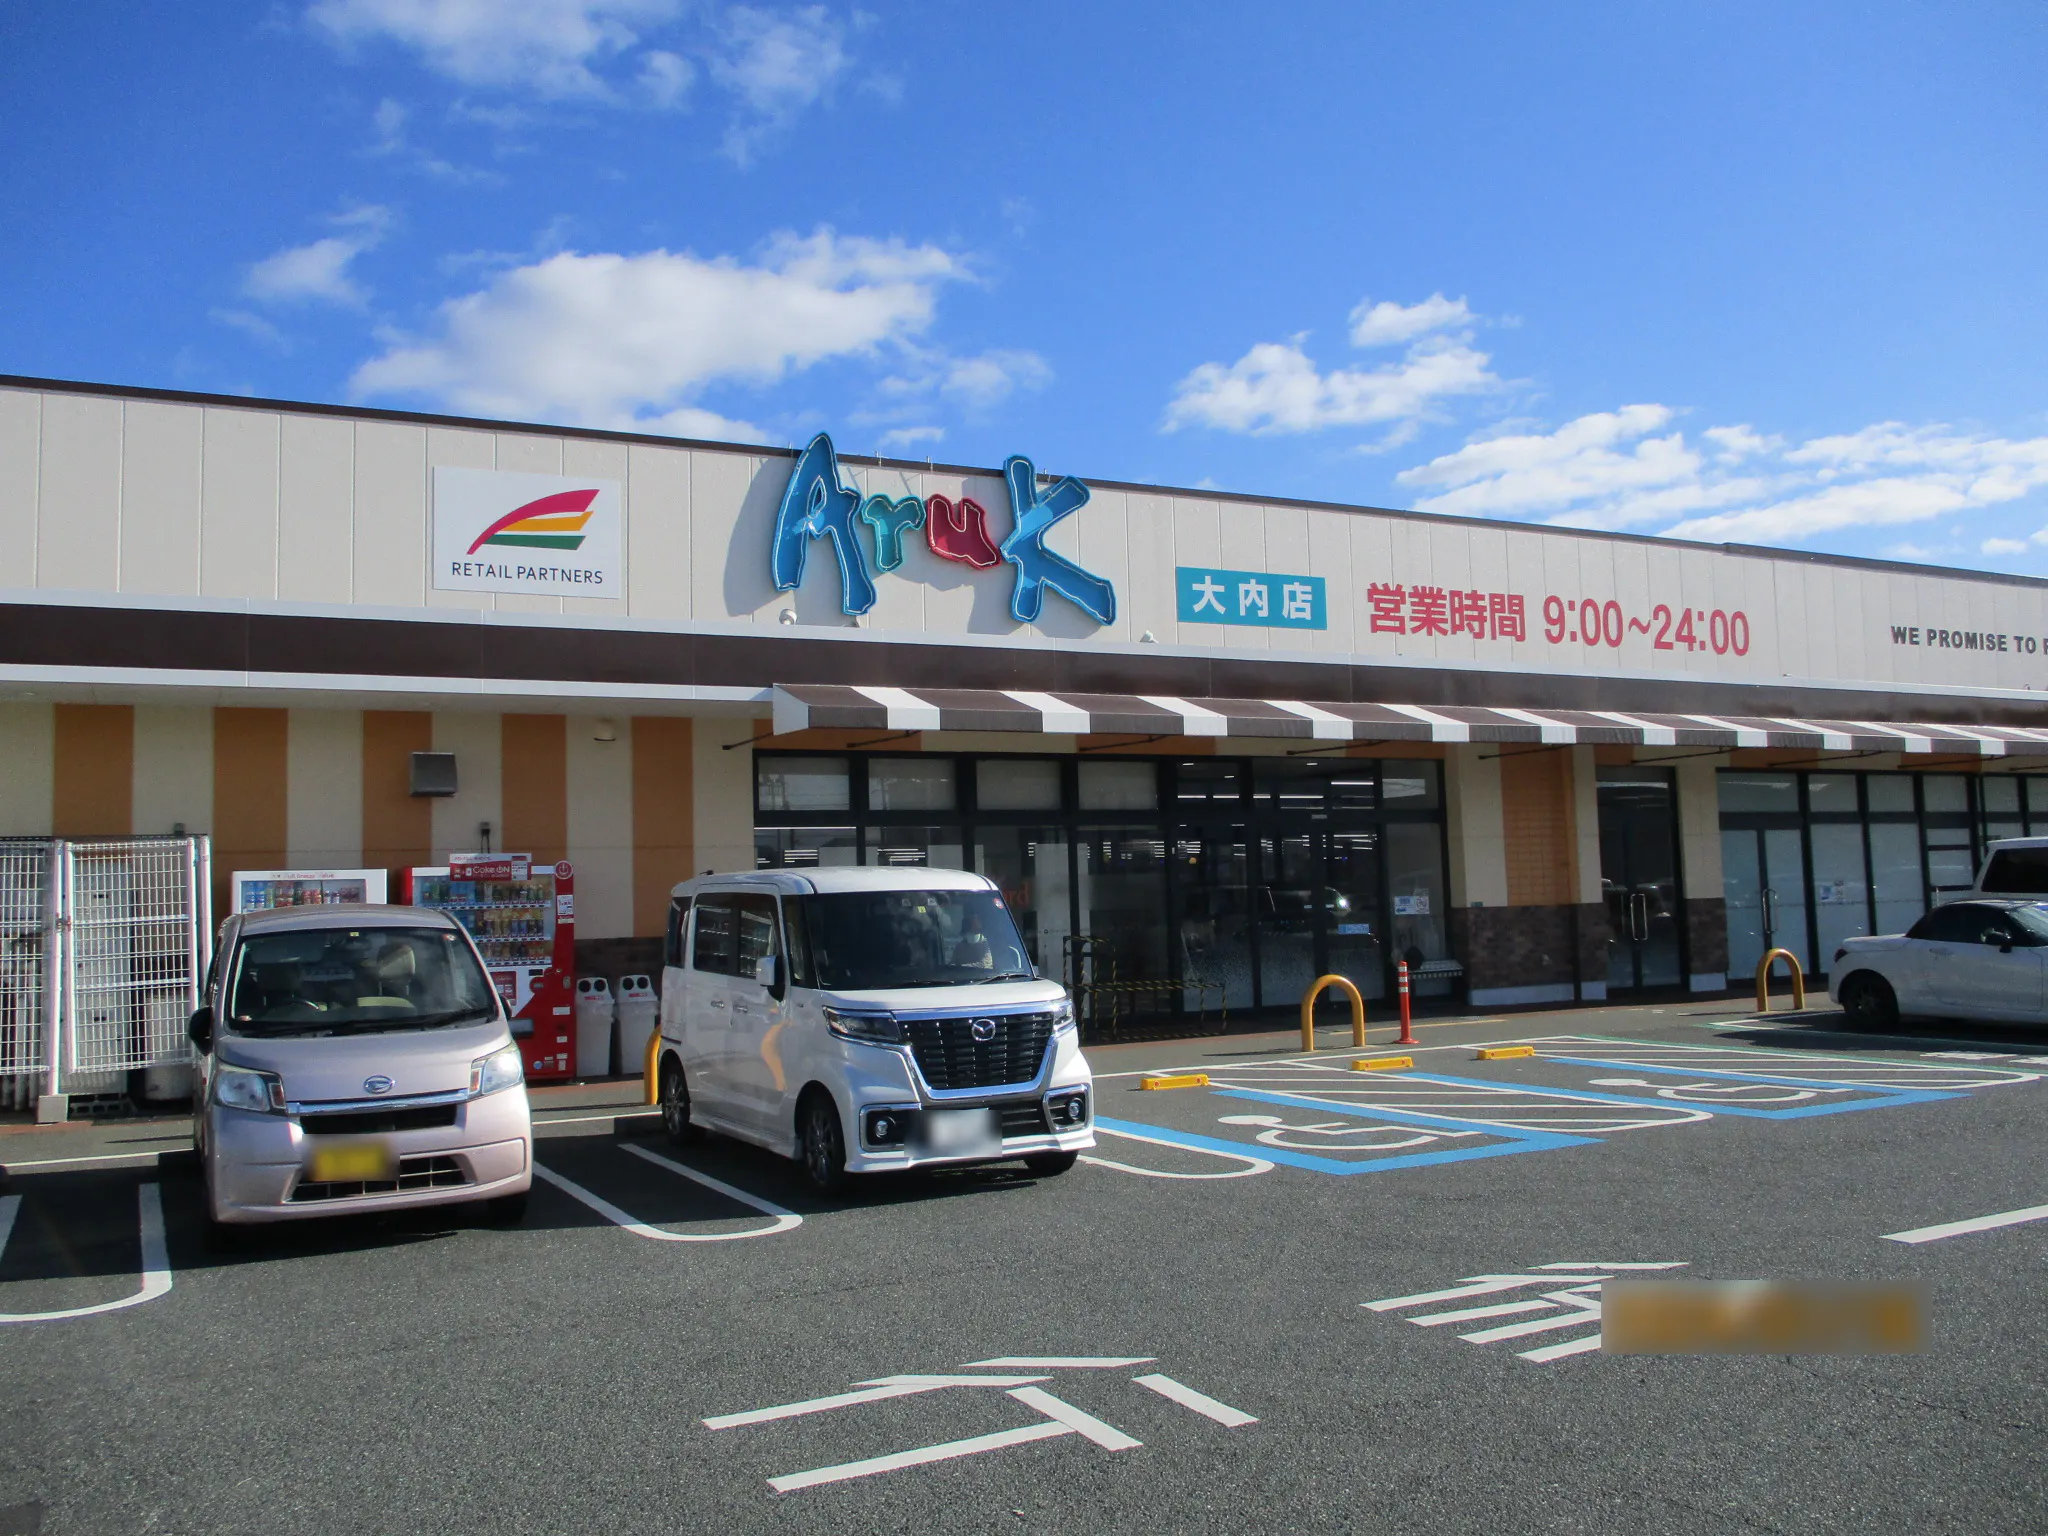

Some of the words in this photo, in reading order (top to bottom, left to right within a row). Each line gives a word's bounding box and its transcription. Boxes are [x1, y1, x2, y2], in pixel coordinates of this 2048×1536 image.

[452, 562, 512, 579] RETAIL
[517, 566, 603, 584] PARTNERS
[1192, 576, 1313, 622] 大内店
[1367, 582, 1527, 642] 営業時間
[1891, 625, 1920, 646] WE
[1927, 628, 2008, 652] PROMISE
[2013, 635, 2037, 654] TO
